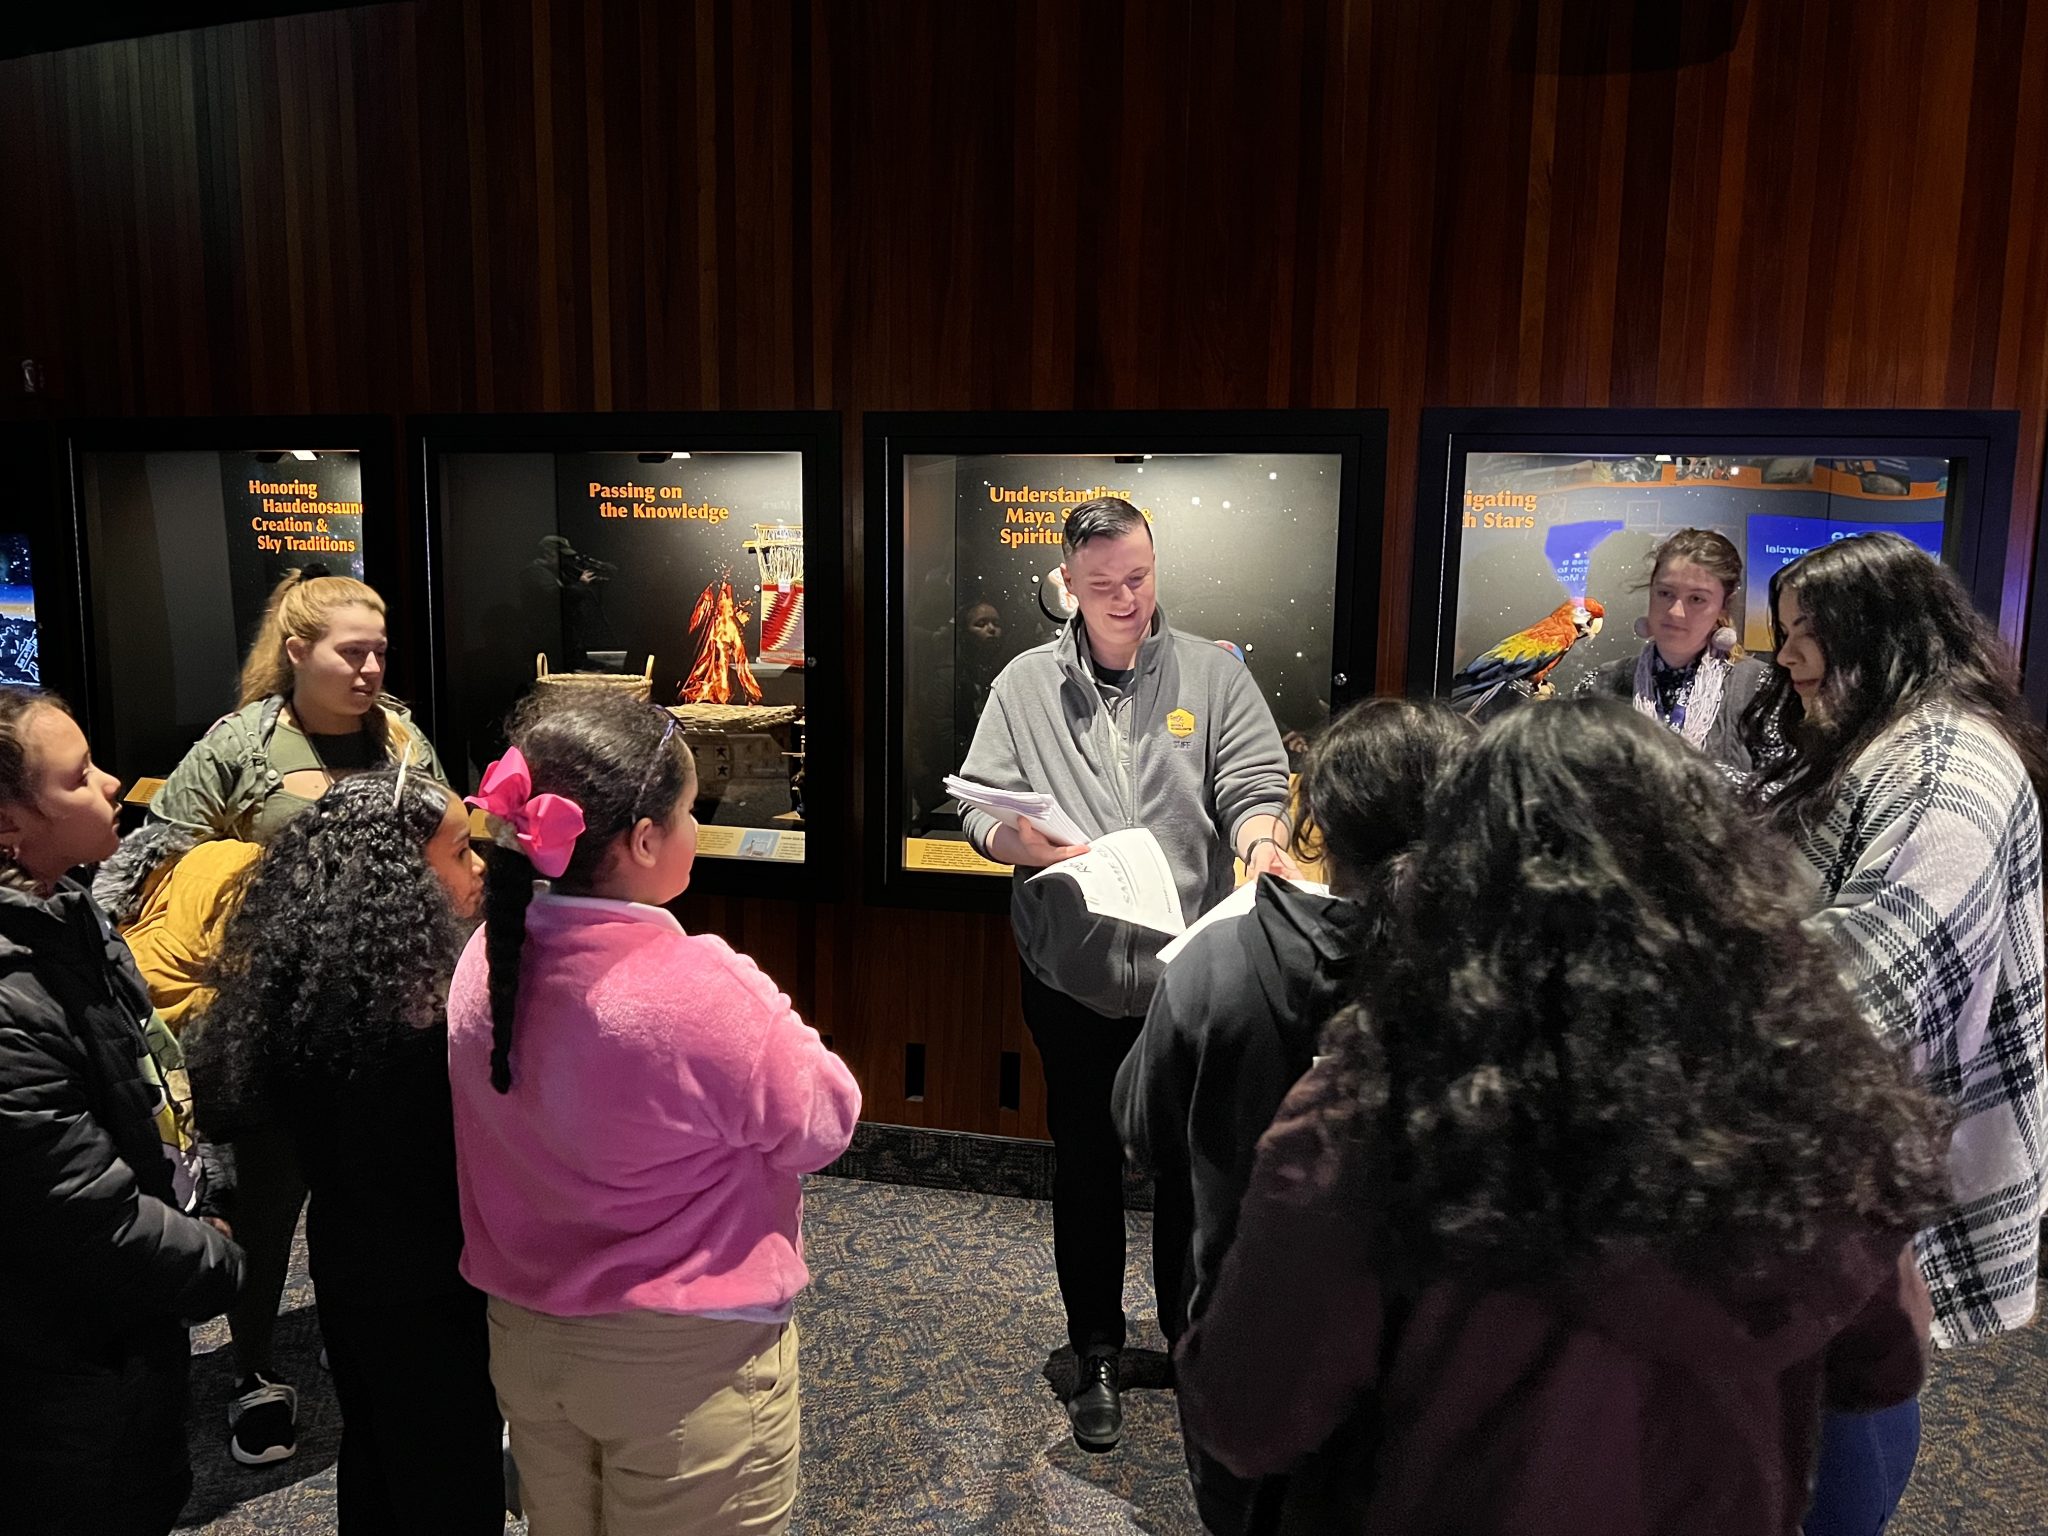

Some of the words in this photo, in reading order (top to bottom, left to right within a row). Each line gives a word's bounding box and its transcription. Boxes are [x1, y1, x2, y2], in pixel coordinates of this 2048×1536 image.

[249, 479, 318, 499] Honoring
[589, 482, 656, 502] Passing
[659, 486, 683, 499] on
[989, 485, 1132, 504] Understanding
[1463, 489, 1537, 511] igating
[599, 502, 628, 518] the
[633, 503, 729, 524] Knowledge
[1005, 508, 1056, 528] Maya
[1462, 511, 1477, 528] h
[1483, 512, 1535, 528] Stars
[252, 516, 313, 532] Creation
[316, 518, 328, 532] &
[257, 535, 282, 554] Sky
[284, 536, 356, 552] Traditions
